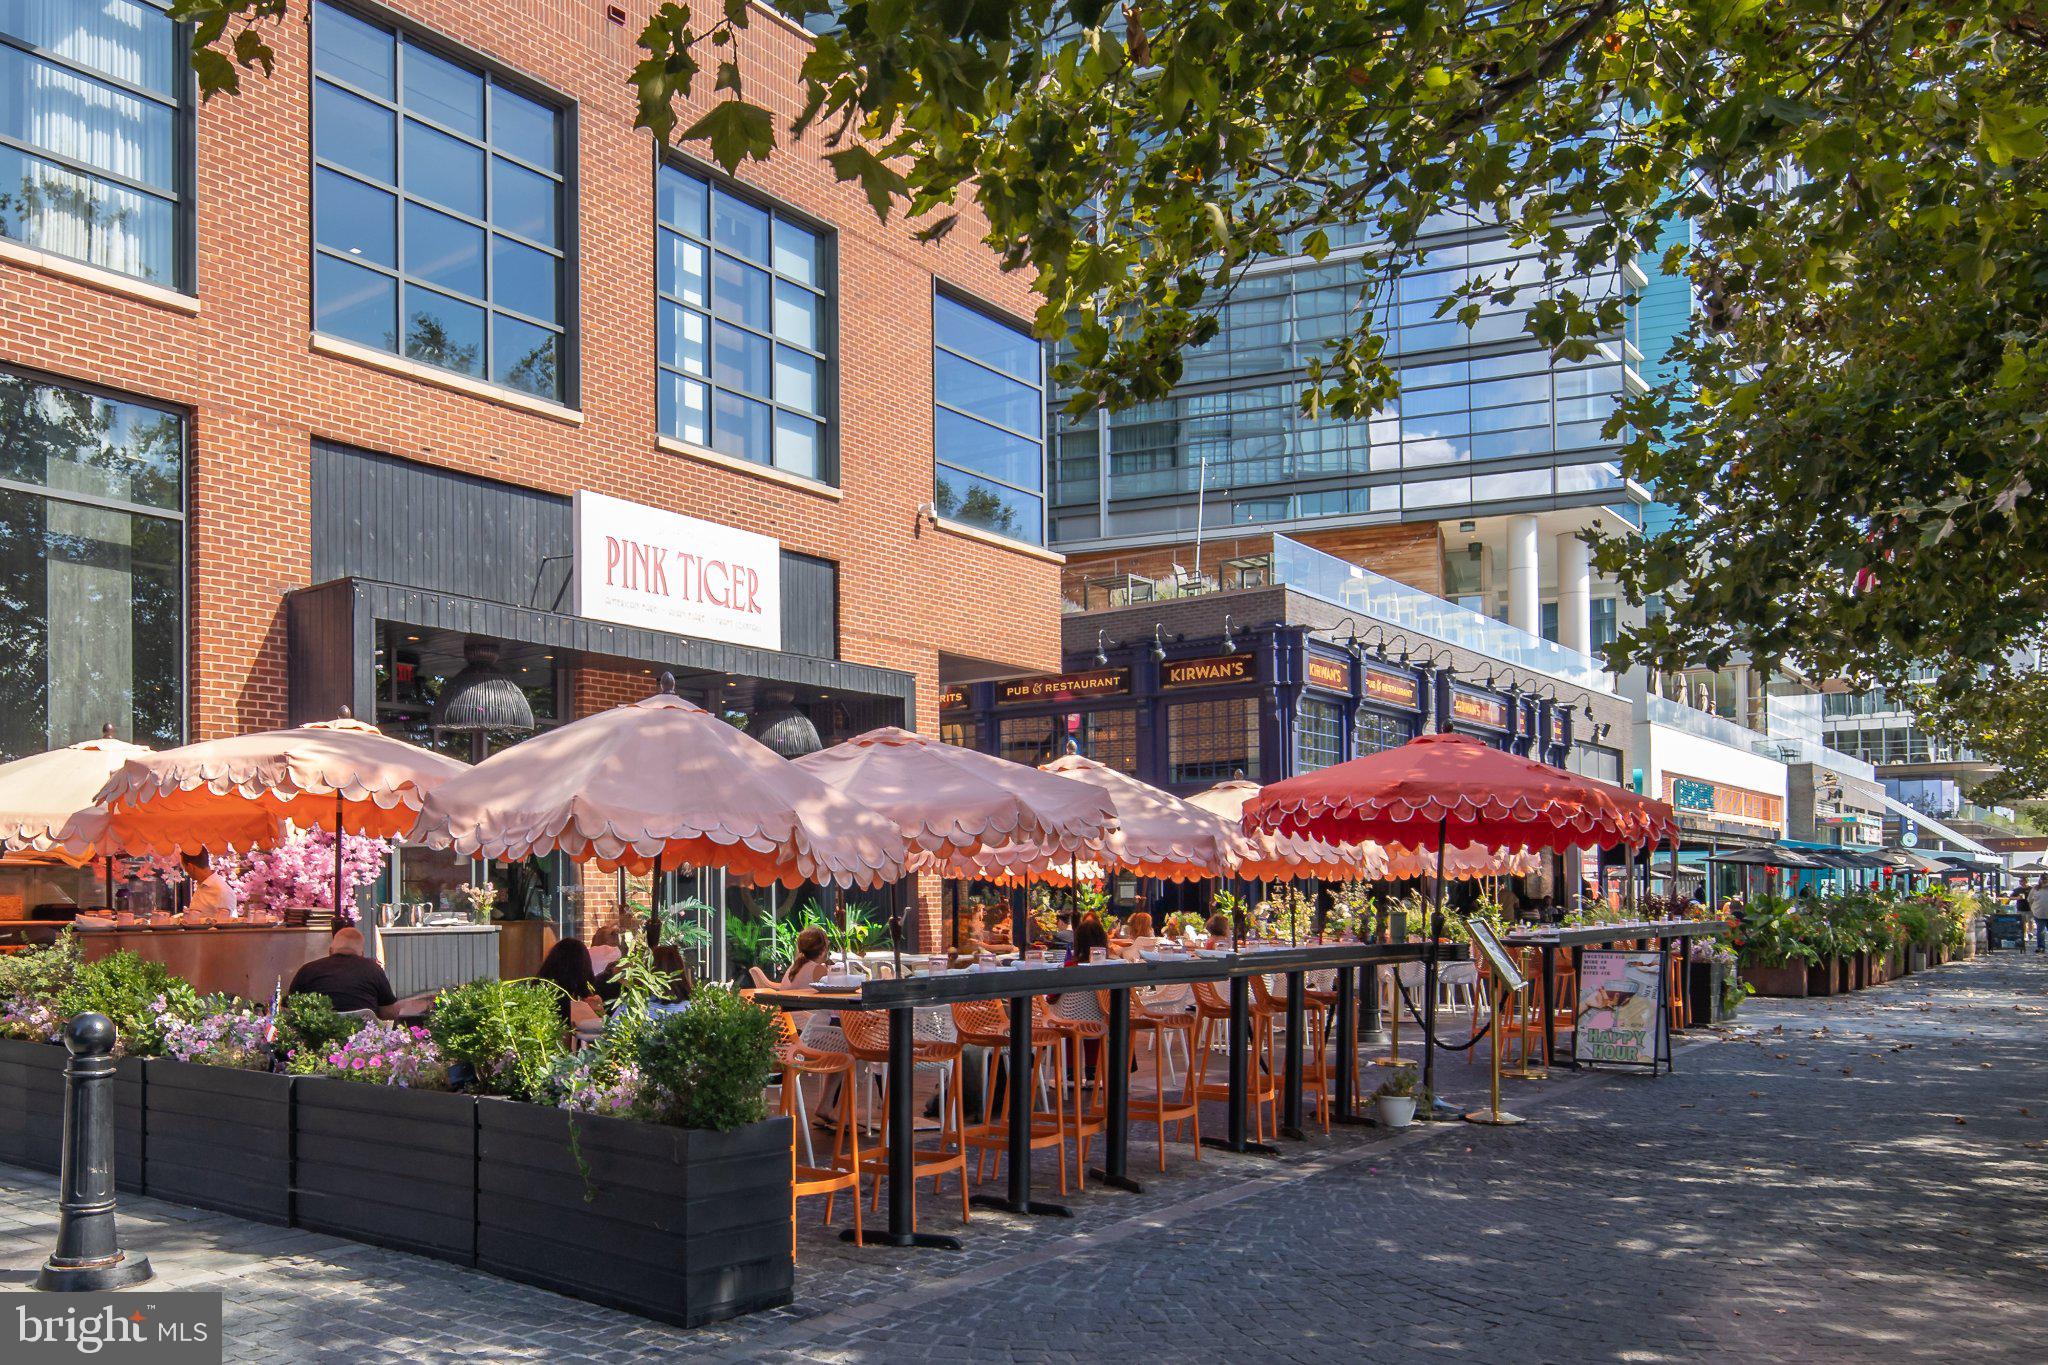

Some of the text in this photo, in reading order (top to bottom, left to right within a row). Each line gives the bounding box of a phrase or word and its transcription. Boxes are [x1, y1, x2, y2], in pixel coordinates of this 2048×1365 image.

[605, 535, 762, 614] PINK TIGER
[1170, 661, 1244, 682] KIRWAN'S
[1308, 662, 1341, 682] KIRWAN'S
[1006, 685, 1030, 697] PUB
[1044, 676, 1121, 692] RESTAURANT
[1382, 682, 1414, 698] RESTAURANT
[1587, 1028, 1646, 1046] HAPPY
[1593, 1044, 1638, 1061] HOUR
